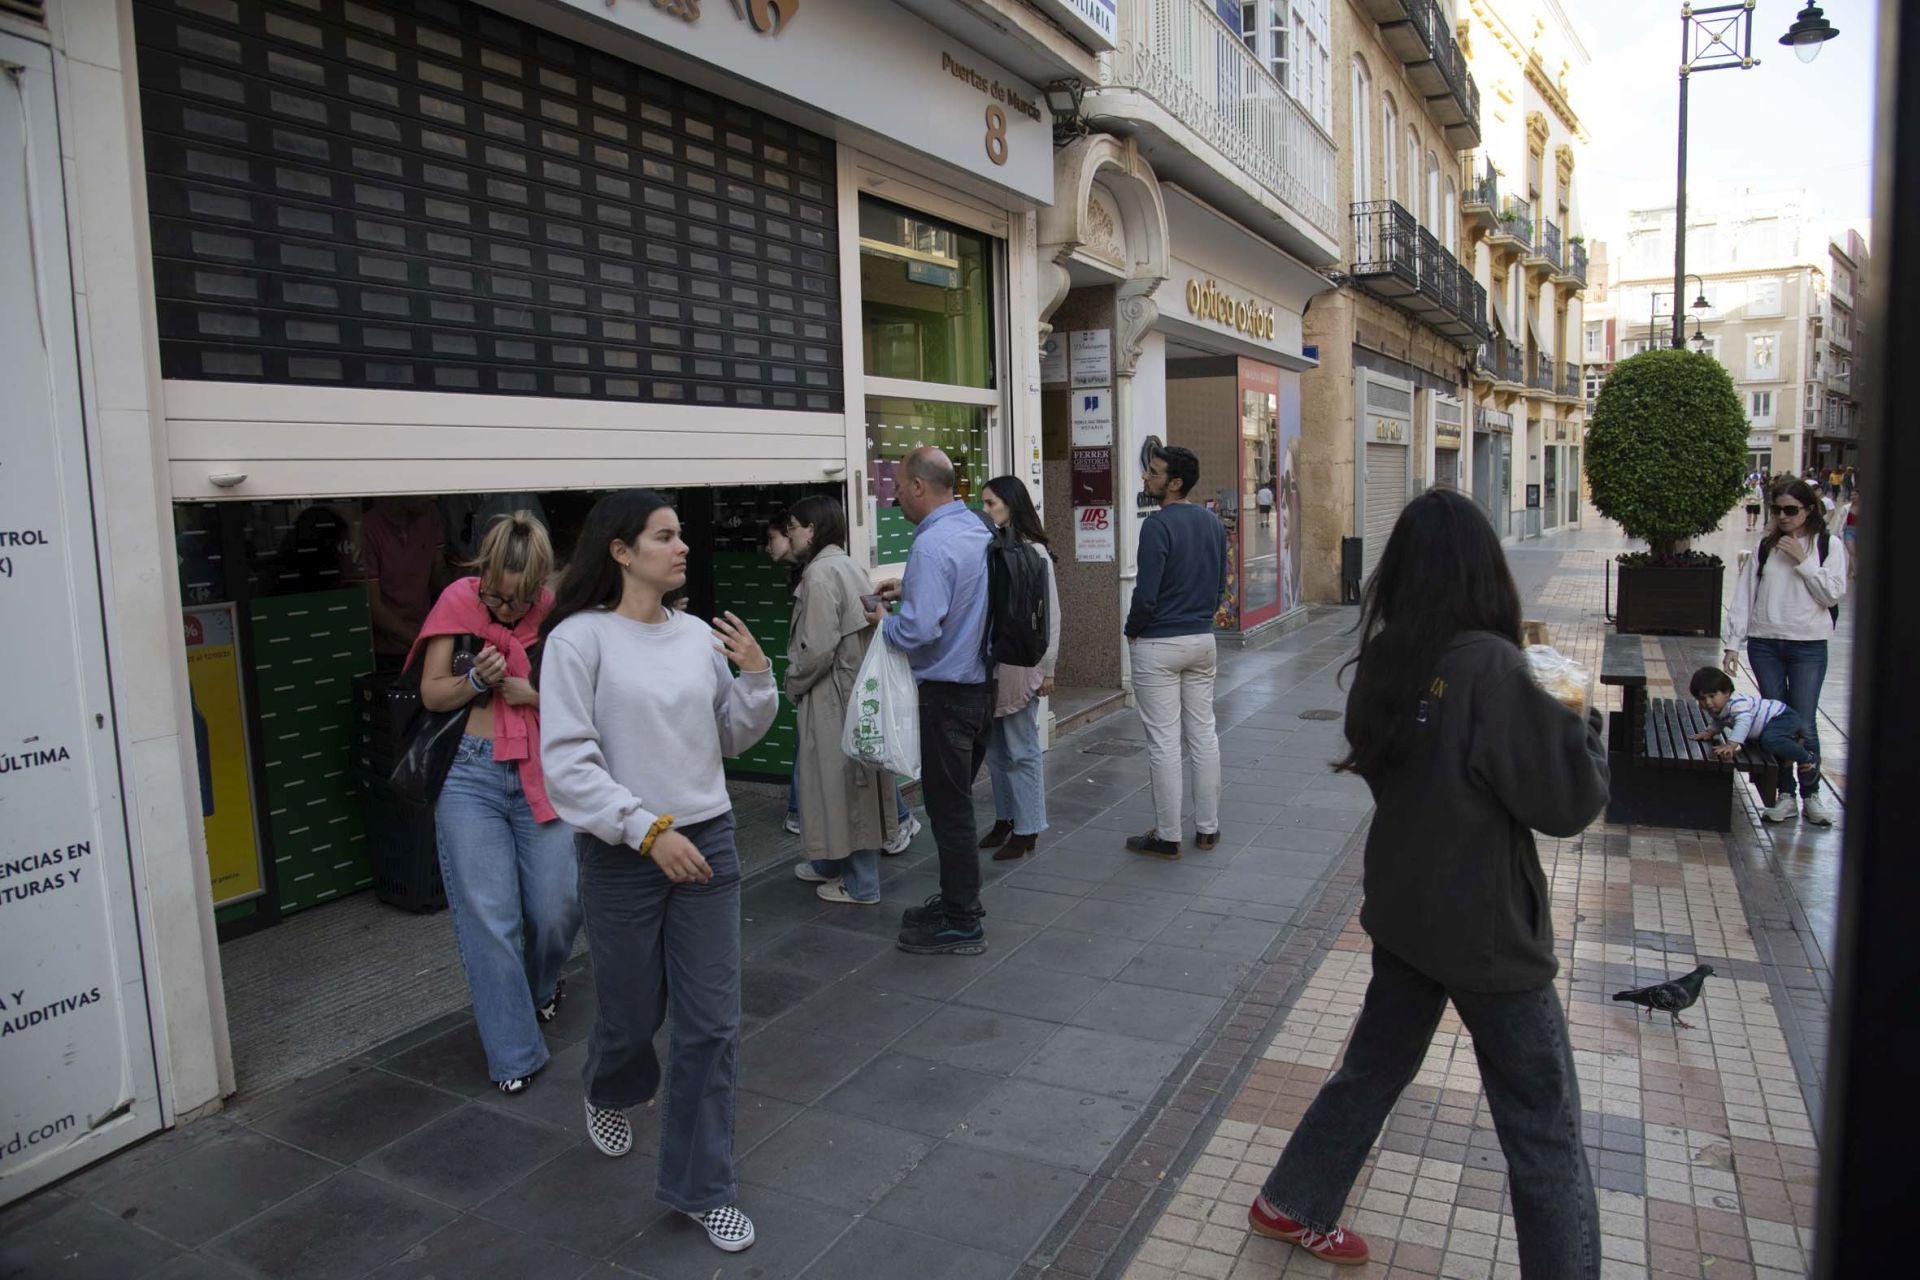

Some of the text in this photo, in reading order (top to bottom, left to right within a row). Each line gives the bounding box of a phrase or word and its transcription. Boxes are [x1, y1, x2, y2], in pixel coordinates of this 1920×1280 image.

[1069, 0, 1111, 34] LIARIA
[942, 50, 1042, 123] Puertas de Murcia
[985, 103, 1009, 167] 8
[1073, 450, 1110, 459] FERRER
[0, 746, 70, 773] ÚLTIMA
[66, 841, 91, 860] EN
[0, 868, 82, 905] TURAS Y
[1, 987, 101, 1037] AUDITIVAS
[11, 989, 25, 1005] Y
